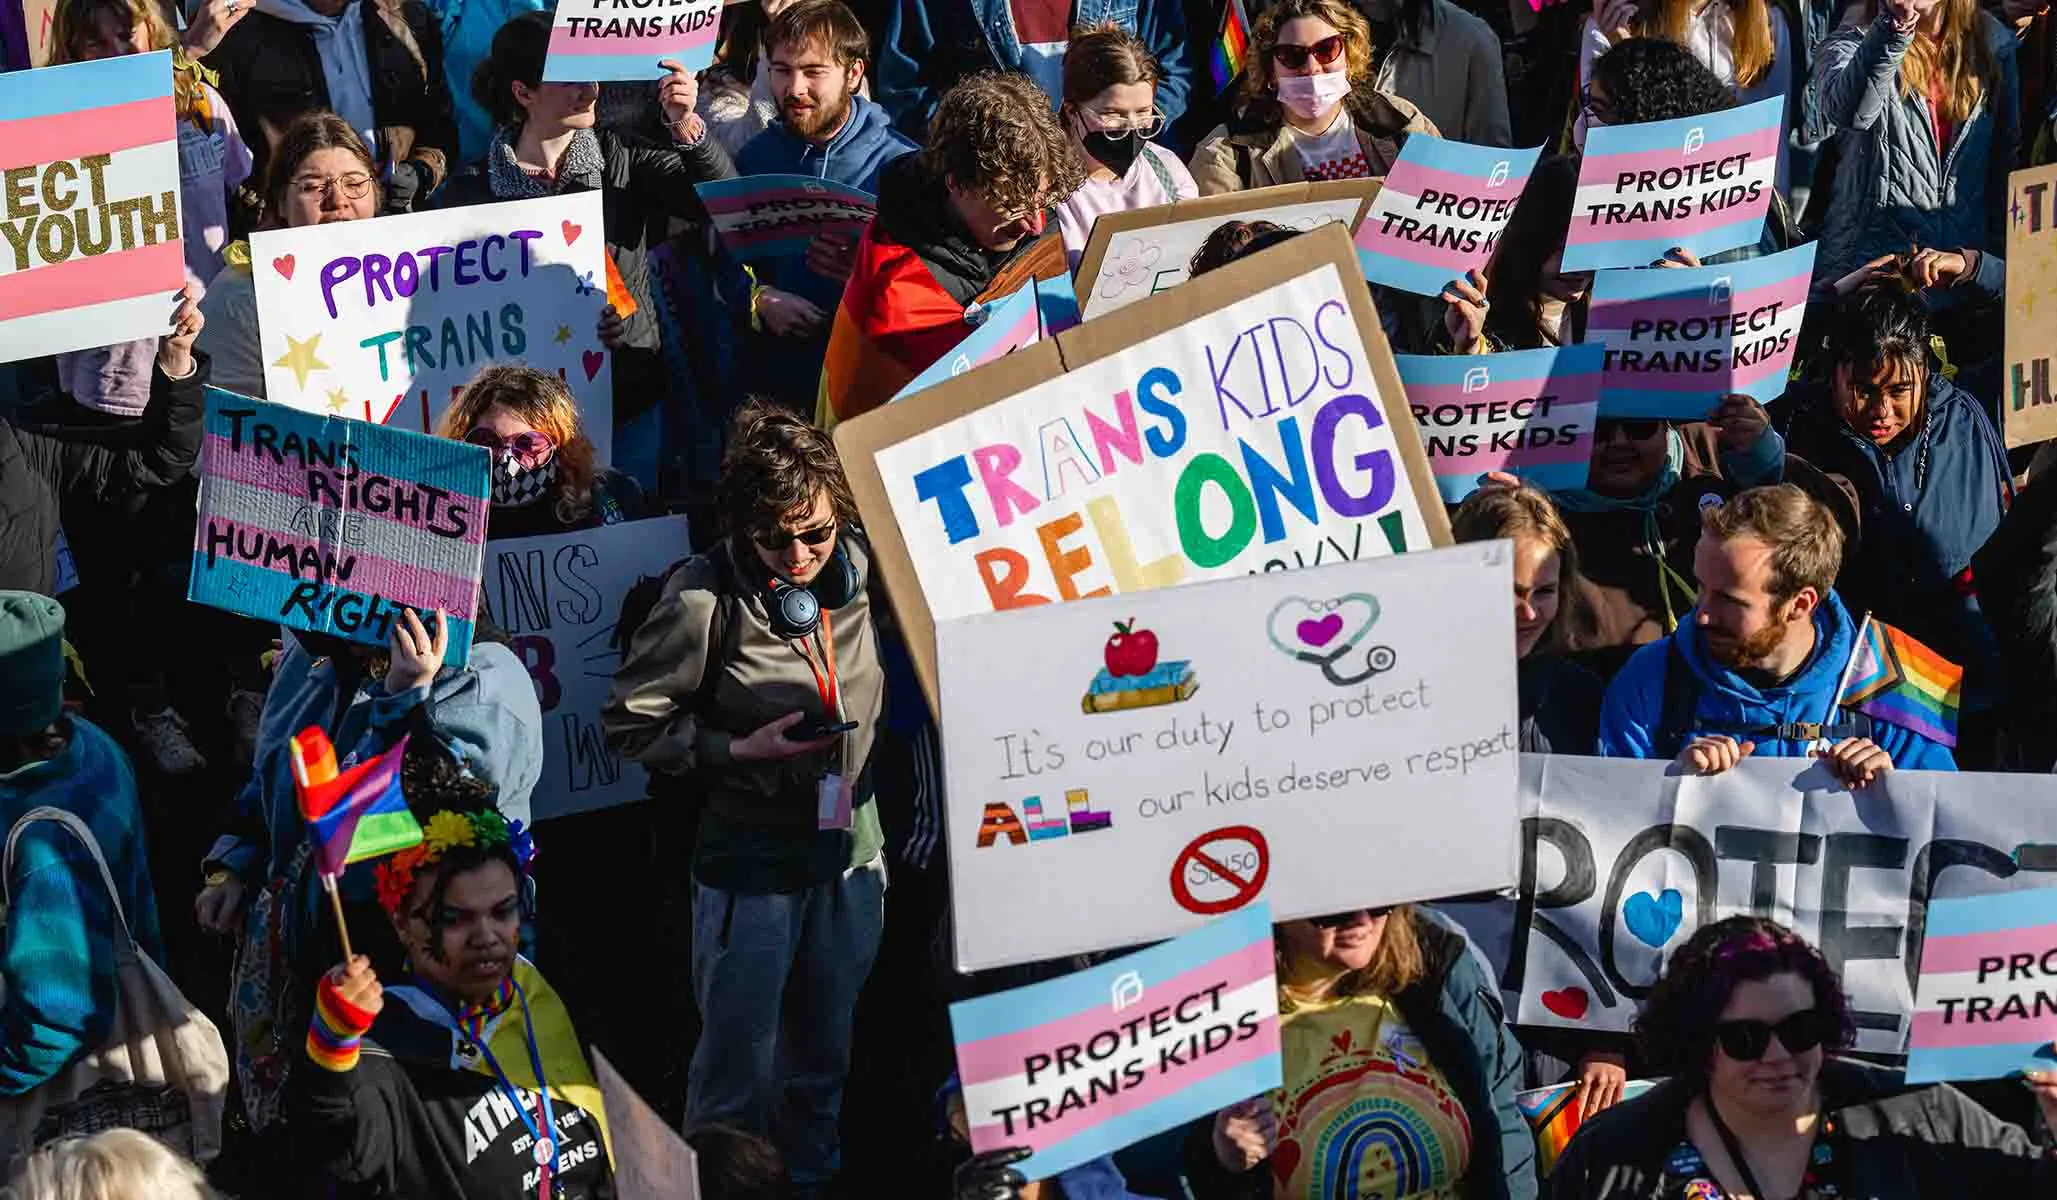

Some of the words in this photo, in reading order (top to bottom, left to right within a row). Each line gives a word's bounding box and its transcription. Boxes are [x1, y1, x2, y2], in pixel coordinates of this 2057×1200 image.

[567, 16, 663, 39] TRANS
[670, 5, 717, 36] KIDS
[4, 152, 112, 220] ECT
[1587, 196, 1693, 225] TRANS
[1699, 179, 1763, 215] KIDS
[1615, 152, 1751, 194] PROTECT
[0, 190, 180, 271] YOUTH
[1380, 211, 1481, 253] TRANS
[320, 230, 543, 319] PROTECT
[359, 302, 527, 381] TRANS
[1602, 349, 1722, 373] TRANS
[1731, 328, 1792, 370] KIDS
[1629, 301, 1783, 342] PROTECT
[218, 408, 360, 481] TRANS
[913, 366, 1186, 545] TRANS
[1204, 300, 1354, 430] KIDS
[1425, 434, 1480, 457] NS
[1490, 424, 1579, 452] KIDS
[290, 506, 368, 546] ARE
[307, 470, 469, 538] RIGHTS
[975, 394, 1396, 612] BELONG
[206, 521, 356, 584] HUMAN
[482, 544, 602, 633] NS
[995, 729, 1065, 781] It's
[1086, 731, 1142, 763] our
[1156, 716, 1234, 754] duty
[1254, 700, 1291, 733] to
[1309, 679, 1432, 735] protect
[976, 788, 1112, 848] ALL
[1138, 786, 1196, 819] our
[1204, 771, 1270, 807] kids
[1278, 761, 1392, 796] deserve
[1406, 722, 1516, 776] respect
[1503, 817, 2057, 1033] ROTEC
[1024, 981, 1229, 1086] PROTECT
[992, 1058, 1145, 1137] TRANS
[1159, 1010, 1259, 1074] KIDS
[522, 1140, 599, 1192] RAENS
